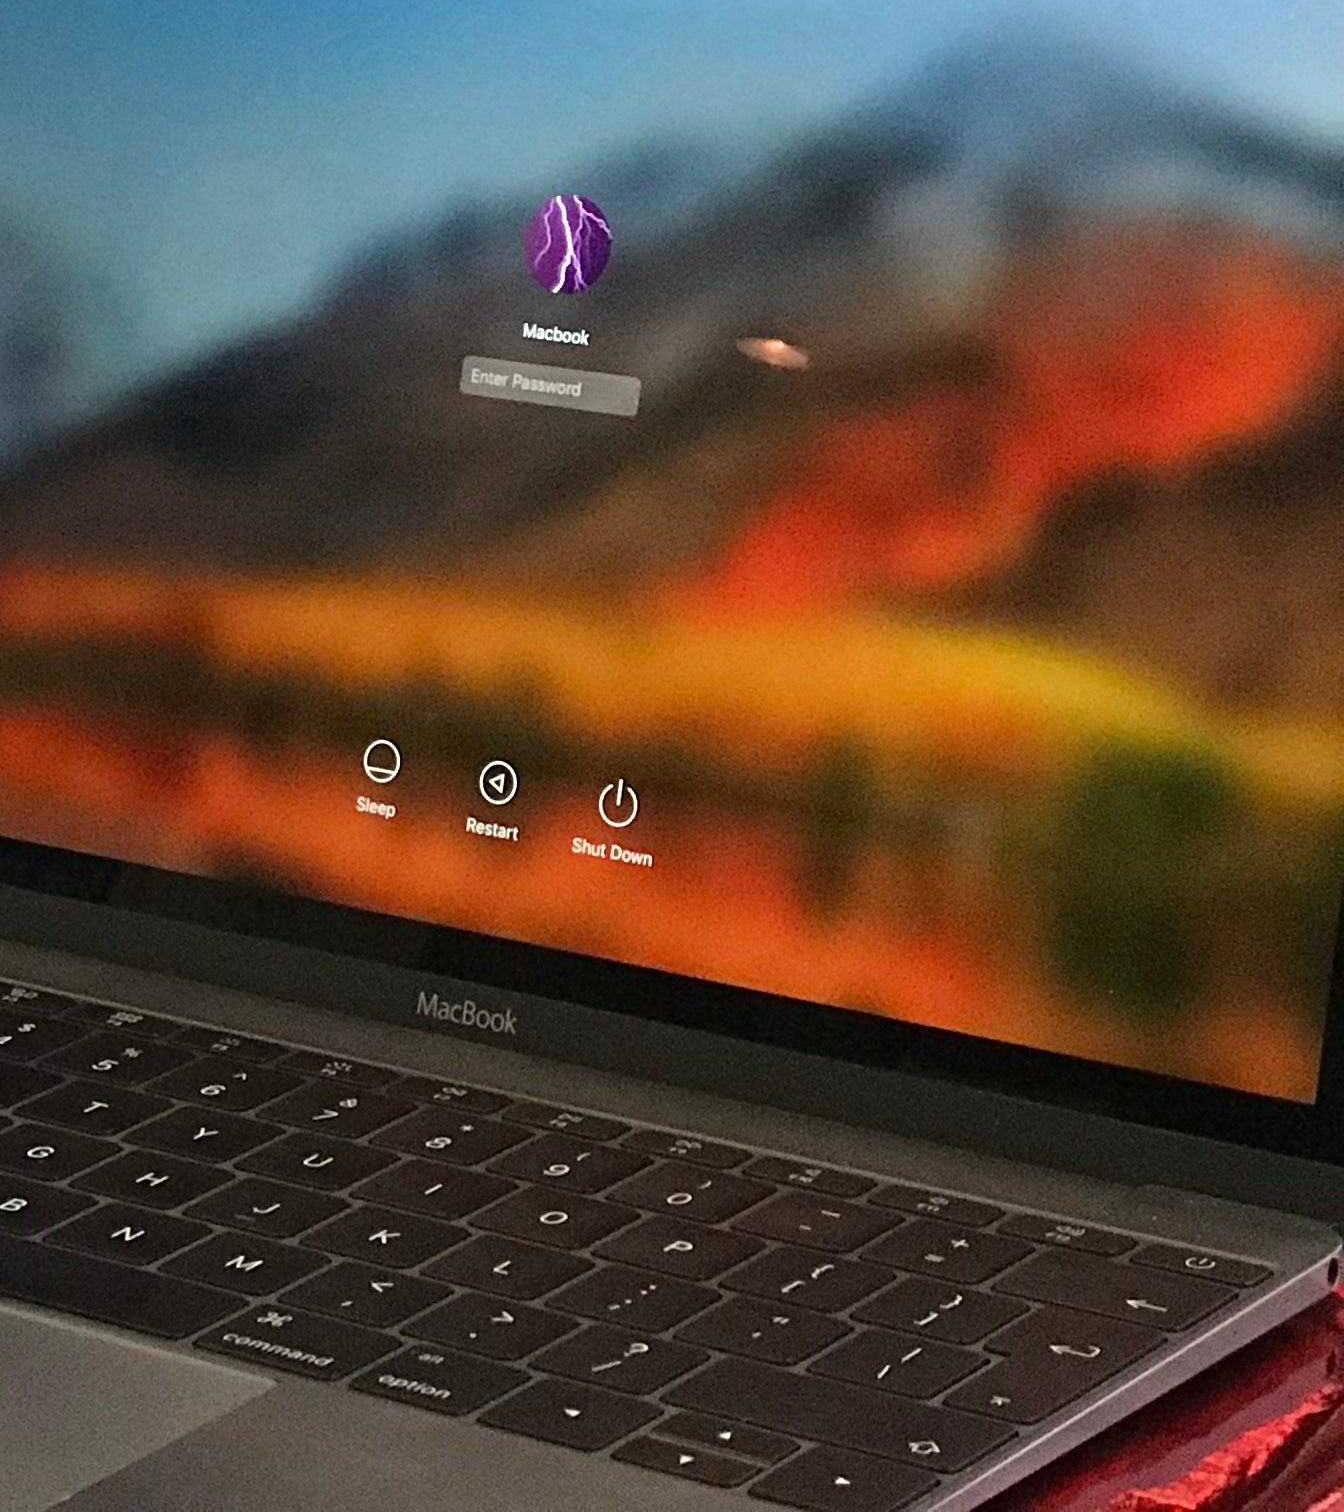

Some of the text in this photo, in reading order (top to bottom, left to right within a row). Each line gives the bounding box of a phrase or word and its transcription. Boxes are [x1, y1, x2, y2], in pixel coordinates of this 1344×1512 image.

[522, 322, 590, 346] Macbook
[470, 367, 584, 398] Enter Password
[355, 795, 396, 820] Sleep
[465, 816, 519, 842] Restart
[571, 837, 653, 867] Shut Down
[416, 990, 517, 1035] MacBook
[82, 1100, 110, 1114] T
[192, 1126, 219, 1141] Y
[25, 1145, 56, 1159] G
[301, 1152, 335, 1169] U
[134, 1171, 170, 1188] H
[251, 1202, 282, 1215] J
[110, 1225, 146, 1243] N
[367, 1228, 402, 1246] K
[662, 1239, 695, 1253] P
[224, 1254, 264, 1272] M
[491, 1259, 512, 1276] L
[221, 1332, 337, 1370] command
[377, 1373, 453, 1401] option
